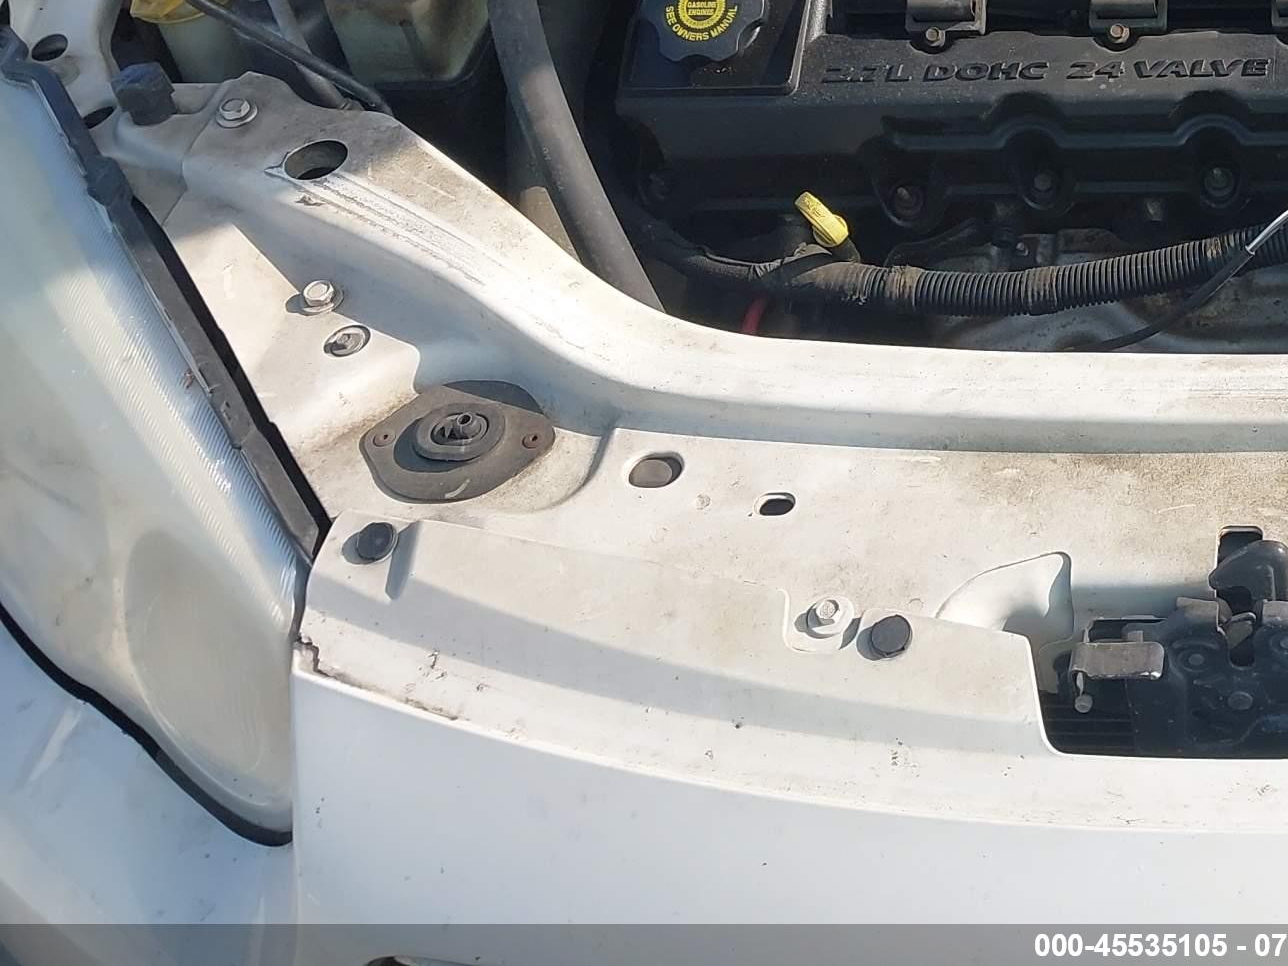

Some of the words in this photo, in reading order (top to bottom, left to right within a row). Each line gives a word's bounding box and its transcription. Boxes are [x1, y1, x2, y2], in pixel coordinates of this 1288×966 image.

[666, 6, 678, 26] SEE
[672, 24, 710, 41] OWNERS
[710, 5, 738, 38] MANUAL
[922, 60, 1050, 82] DOHC
[1066, 60, 1125, 80] 24
[1132, 58, 1272, 78] VALVE
